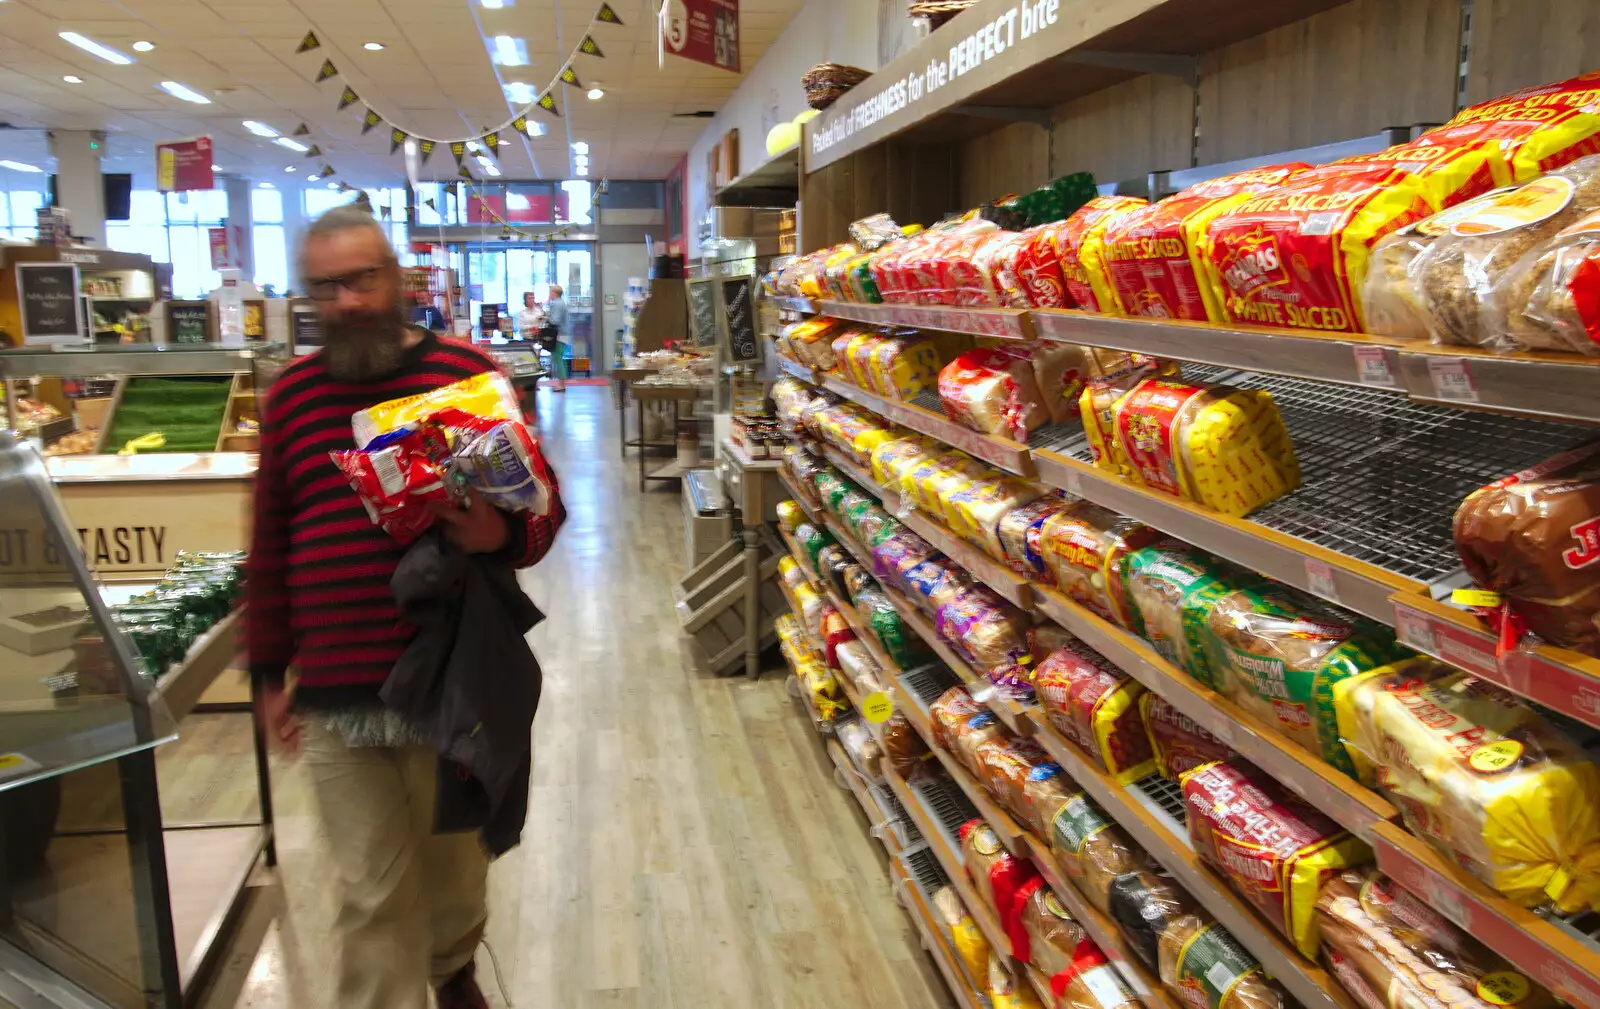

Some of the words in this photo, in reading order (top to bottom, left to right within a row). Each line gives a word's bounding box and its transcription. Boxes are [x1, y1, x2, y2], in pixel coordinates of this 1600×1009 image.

[812, 120, 834, 154] Packed
[833, 115, 846, 142] full
[855, 78, 908, 130] FRESHNESS
[907, 71, 925, 103] for
[926, 58, 948, 93] the
[948, 7, 1018, 82] PERFECT
[1020, 0, 1060, 40] bite
[1222, 198, 1280, 216] WHITE
[1279, 192, 1351, 212] SLICED
[1261, 288, 1301, 303] Premium
[1284, 302, 1348, 330] SLICED
[77, 527, 166, 565] TASTY
[1384, 678, 1458, 729] SLICED
[1231, 799, 1303, 859] Hi-Fibre
